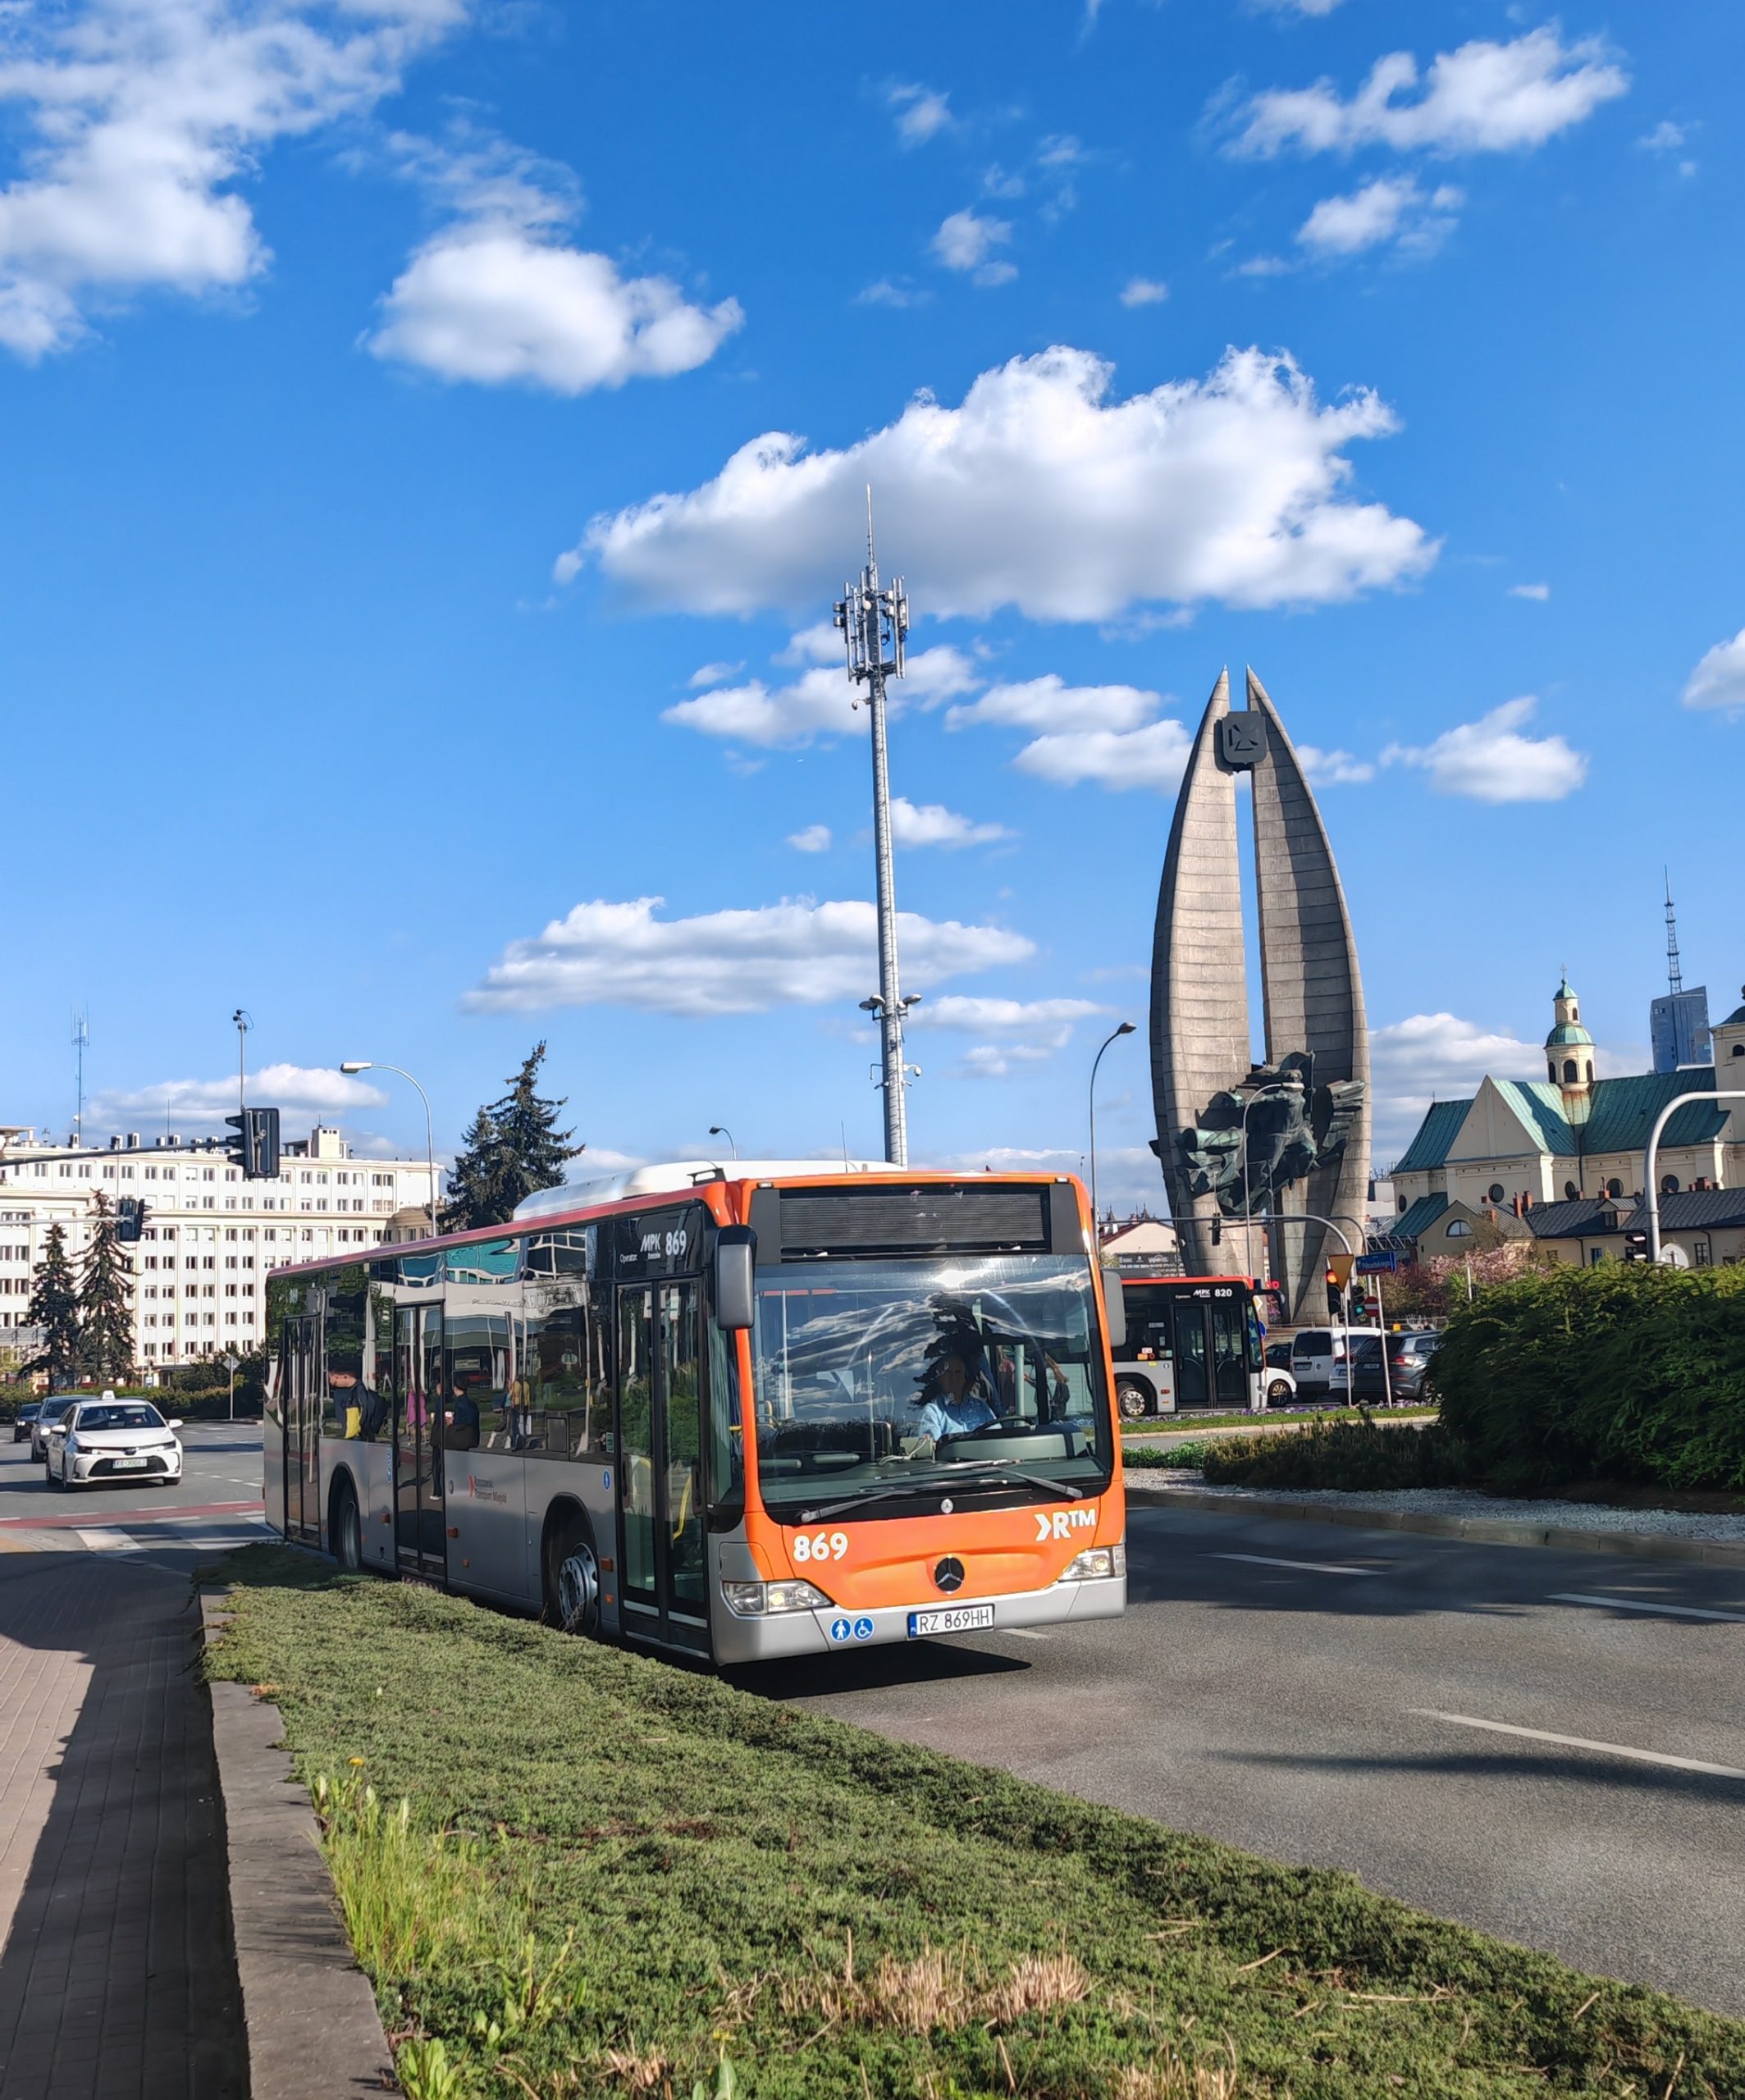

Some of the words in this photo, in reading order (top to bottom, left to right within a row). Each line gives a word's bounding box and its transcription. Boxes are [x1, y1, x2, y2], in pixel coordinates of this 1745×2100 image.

[640, 1233, 661, 1253] MPK
[665, 1230, 687, 1256] 869
[1214, 1288, 1232, 1297] 820
[1052, 1508, 1096, 1540] RTM
[793, 1532, 848, 1562] 869
[920, 1614, 939, 1632] RZ
[944, 1609, 989, 1628] 869HH
